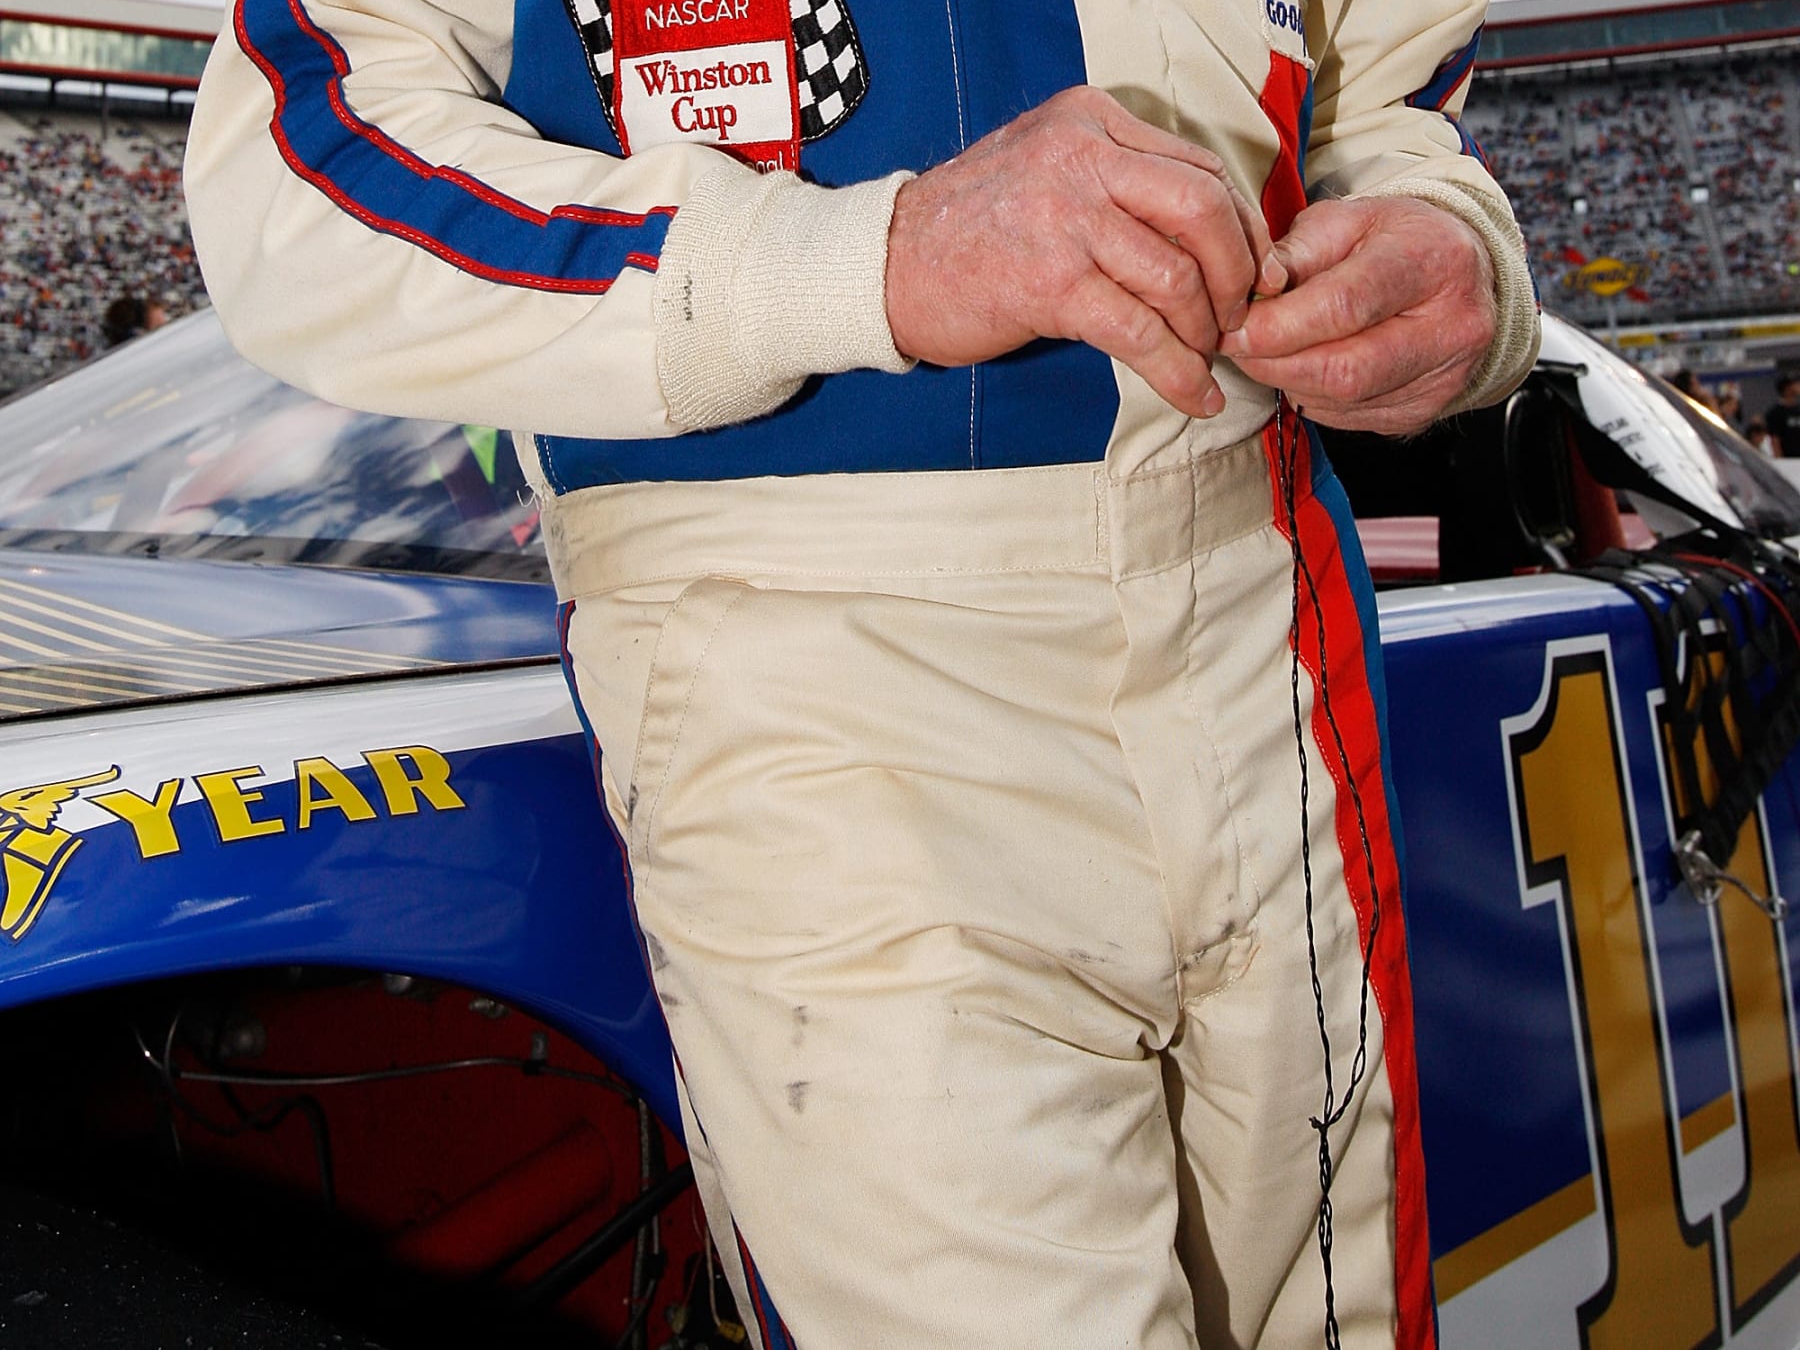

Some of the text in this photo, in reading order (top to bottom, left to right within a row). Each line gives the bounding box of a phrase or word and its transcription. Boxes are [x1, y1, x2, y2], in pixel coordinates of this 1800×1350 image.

[635, 60, 772, 96] Winston
[671, 96, 737, 140] Cup
[84, 744, 468, 860] YEAR
